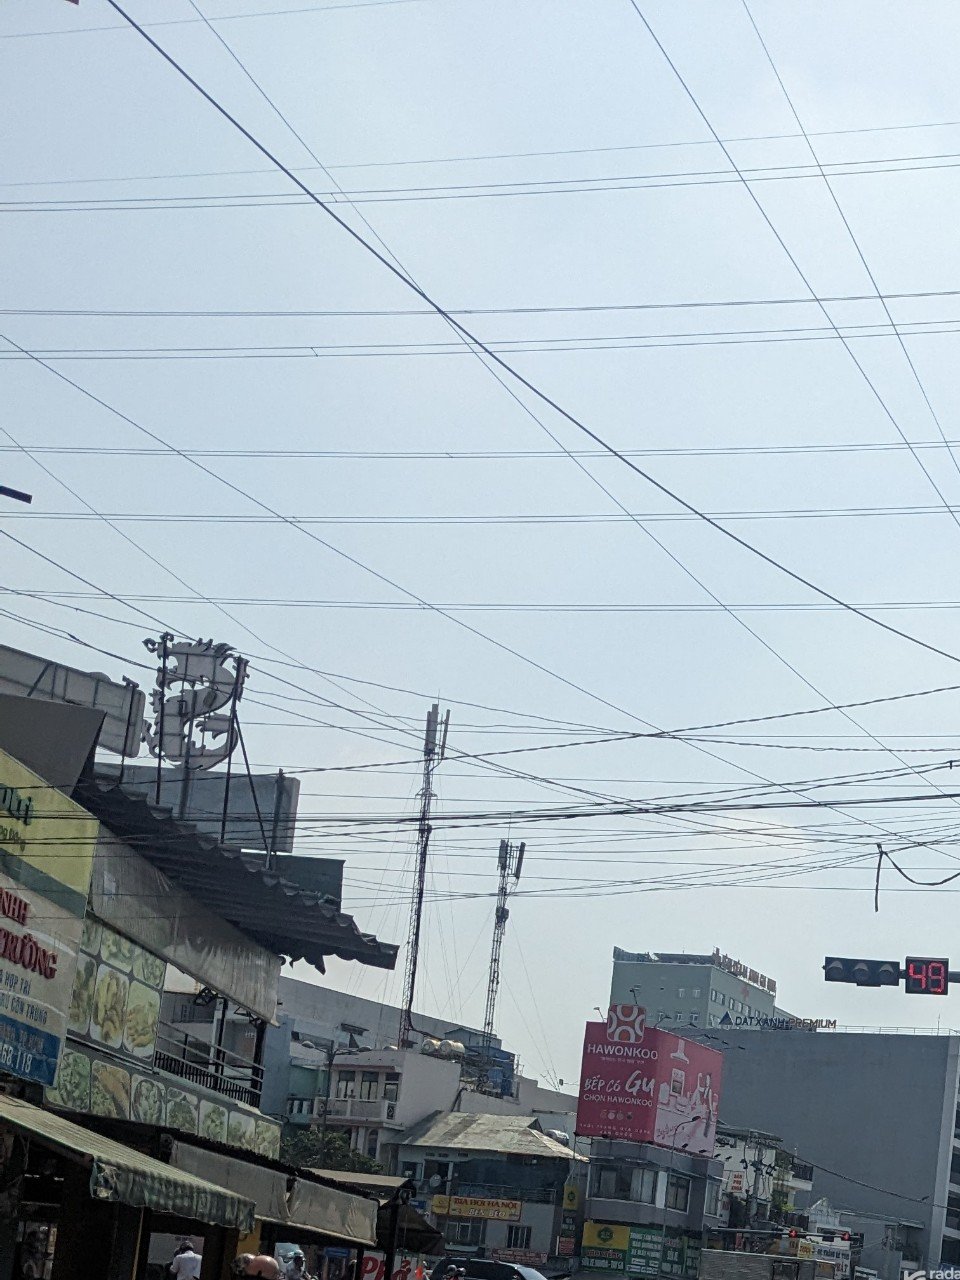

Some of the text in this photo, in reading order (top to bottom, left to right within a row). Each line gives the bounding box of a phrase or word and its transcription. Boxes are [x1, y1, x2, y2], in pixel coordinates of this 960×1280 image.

[908, 962, 945, 993] 49
[788, 1017, 837, 1029] PREMIUM
[587, 1044, 658, 1060] HAWONKOO
